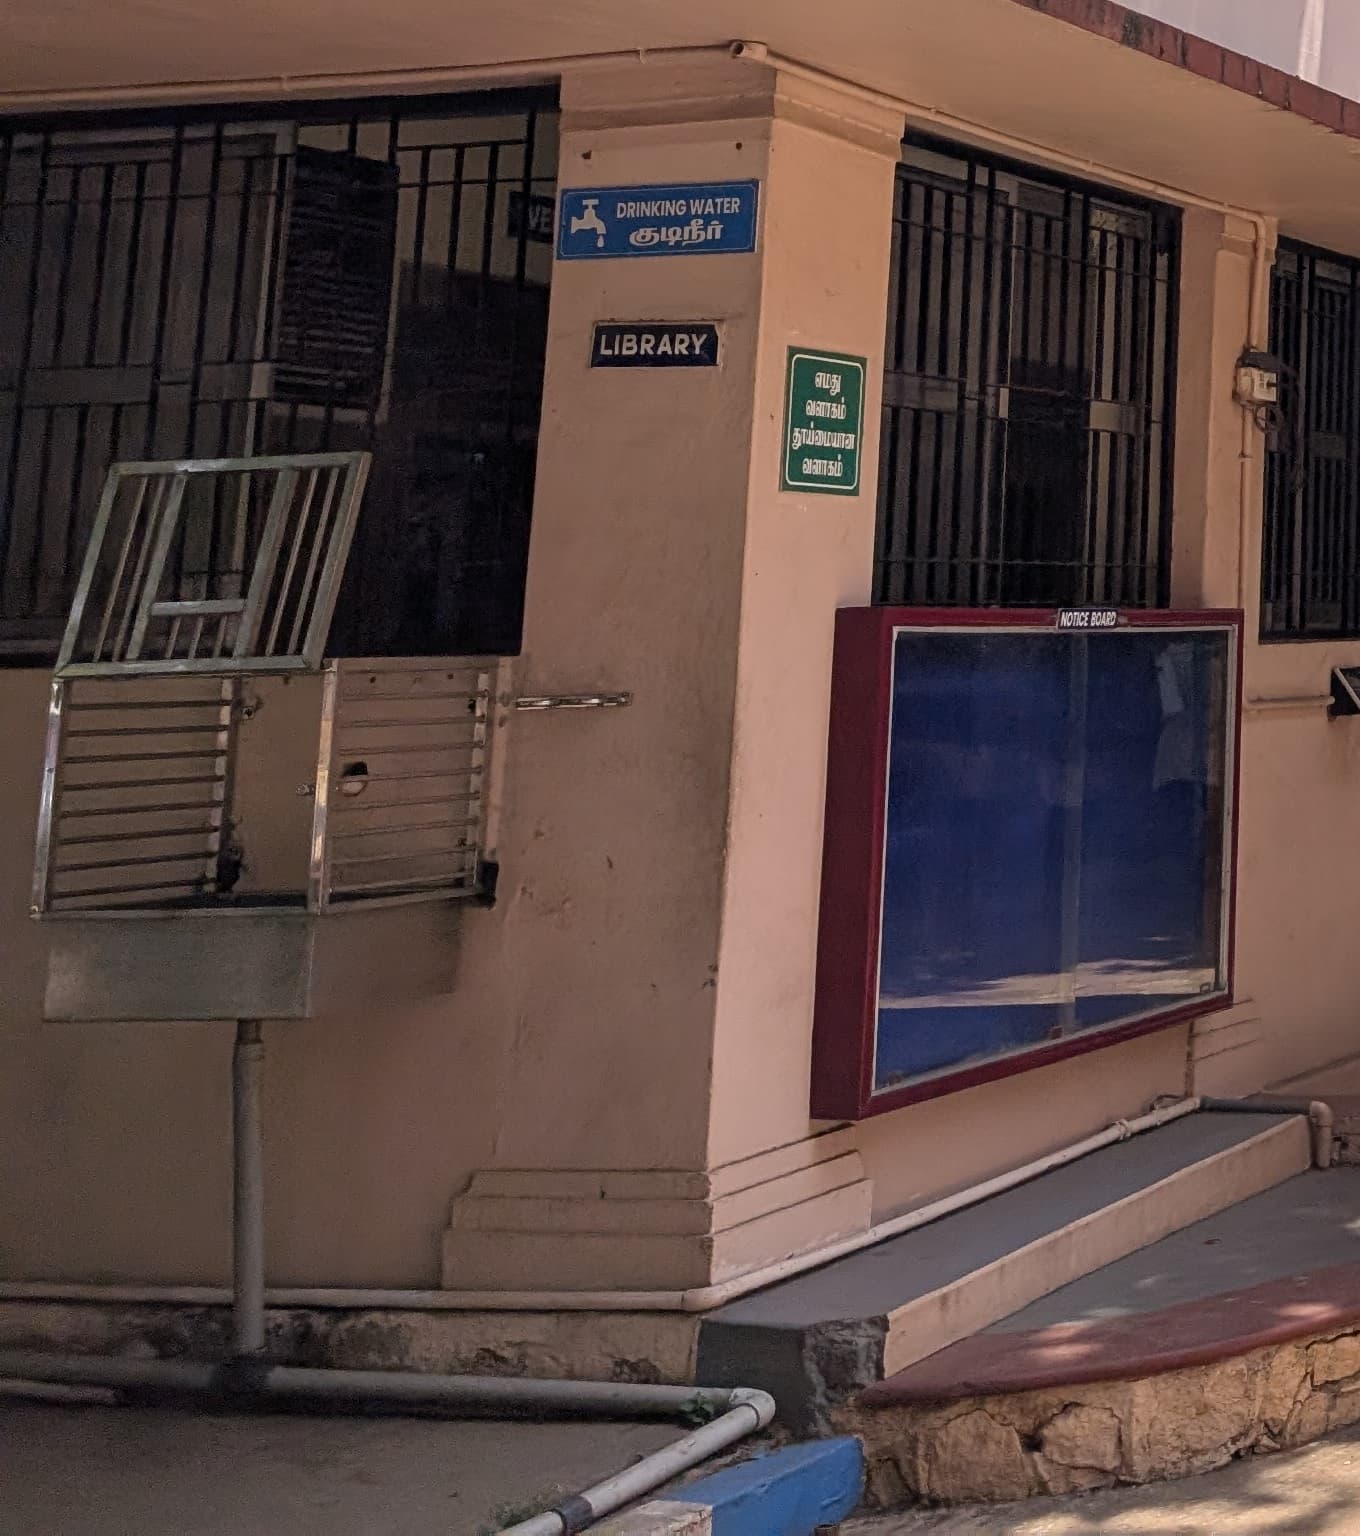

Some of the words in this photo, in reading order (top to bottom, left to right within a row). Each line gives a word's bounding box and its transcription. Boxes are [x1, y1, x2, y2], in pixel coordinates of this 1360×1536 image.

[616, 199, 687, 219] DRINKING
[689, 197, 741, 216] WATER
[629, 219, 724, 247] குடிநீர்
[600, 333, 708, 356] LIBRARY
[814, 371, 842, 396] எமது
[805, 396, 847, 420] வளாகம்
[802, 453, 844, 477] வளாகம்
[1060, 611, 1089, 627] NOTICE
[1090, 611, 1117, 627] BOARD
